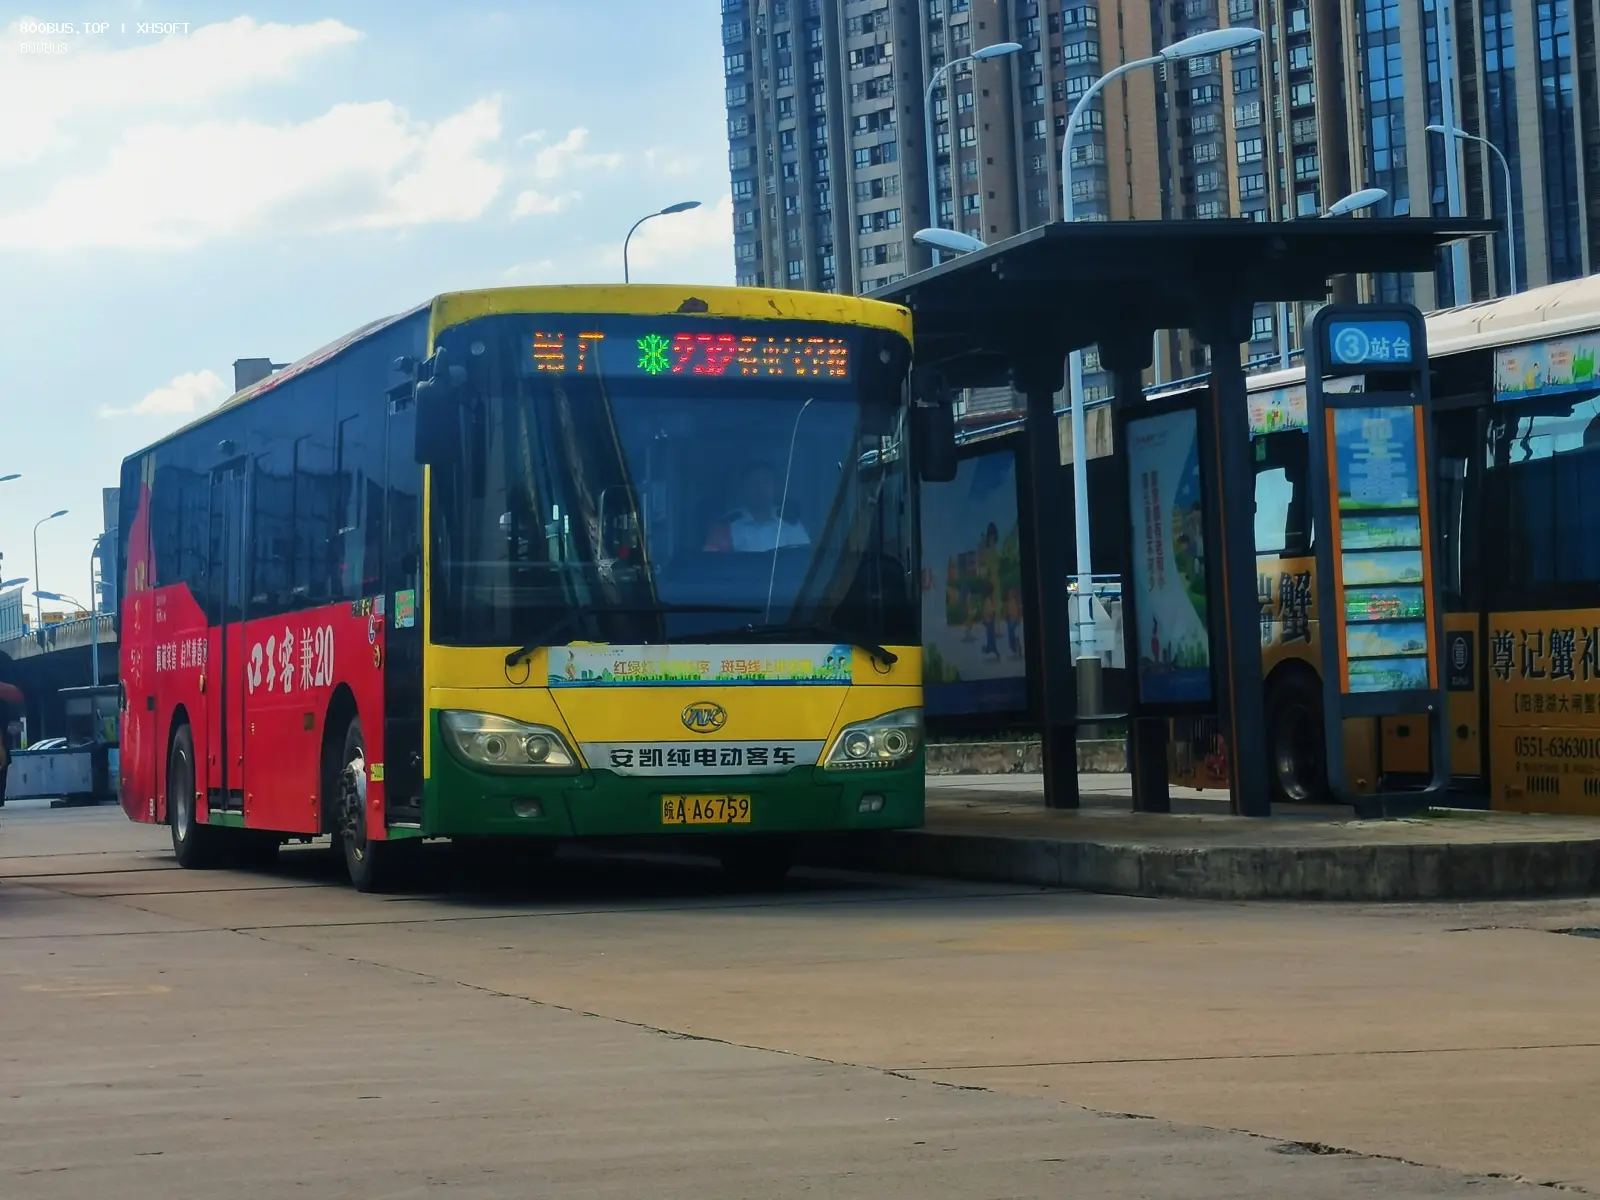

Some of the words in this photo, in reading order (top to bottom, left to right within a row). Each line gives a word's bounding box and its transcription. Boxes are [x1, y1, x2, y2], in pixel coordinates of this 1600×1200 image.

[613, 660, 710, 675] 红绿灯序
[721, 659, 813, 674] 斑马线上文
[610, 747, 796, 768] 安凯纯电动客车
